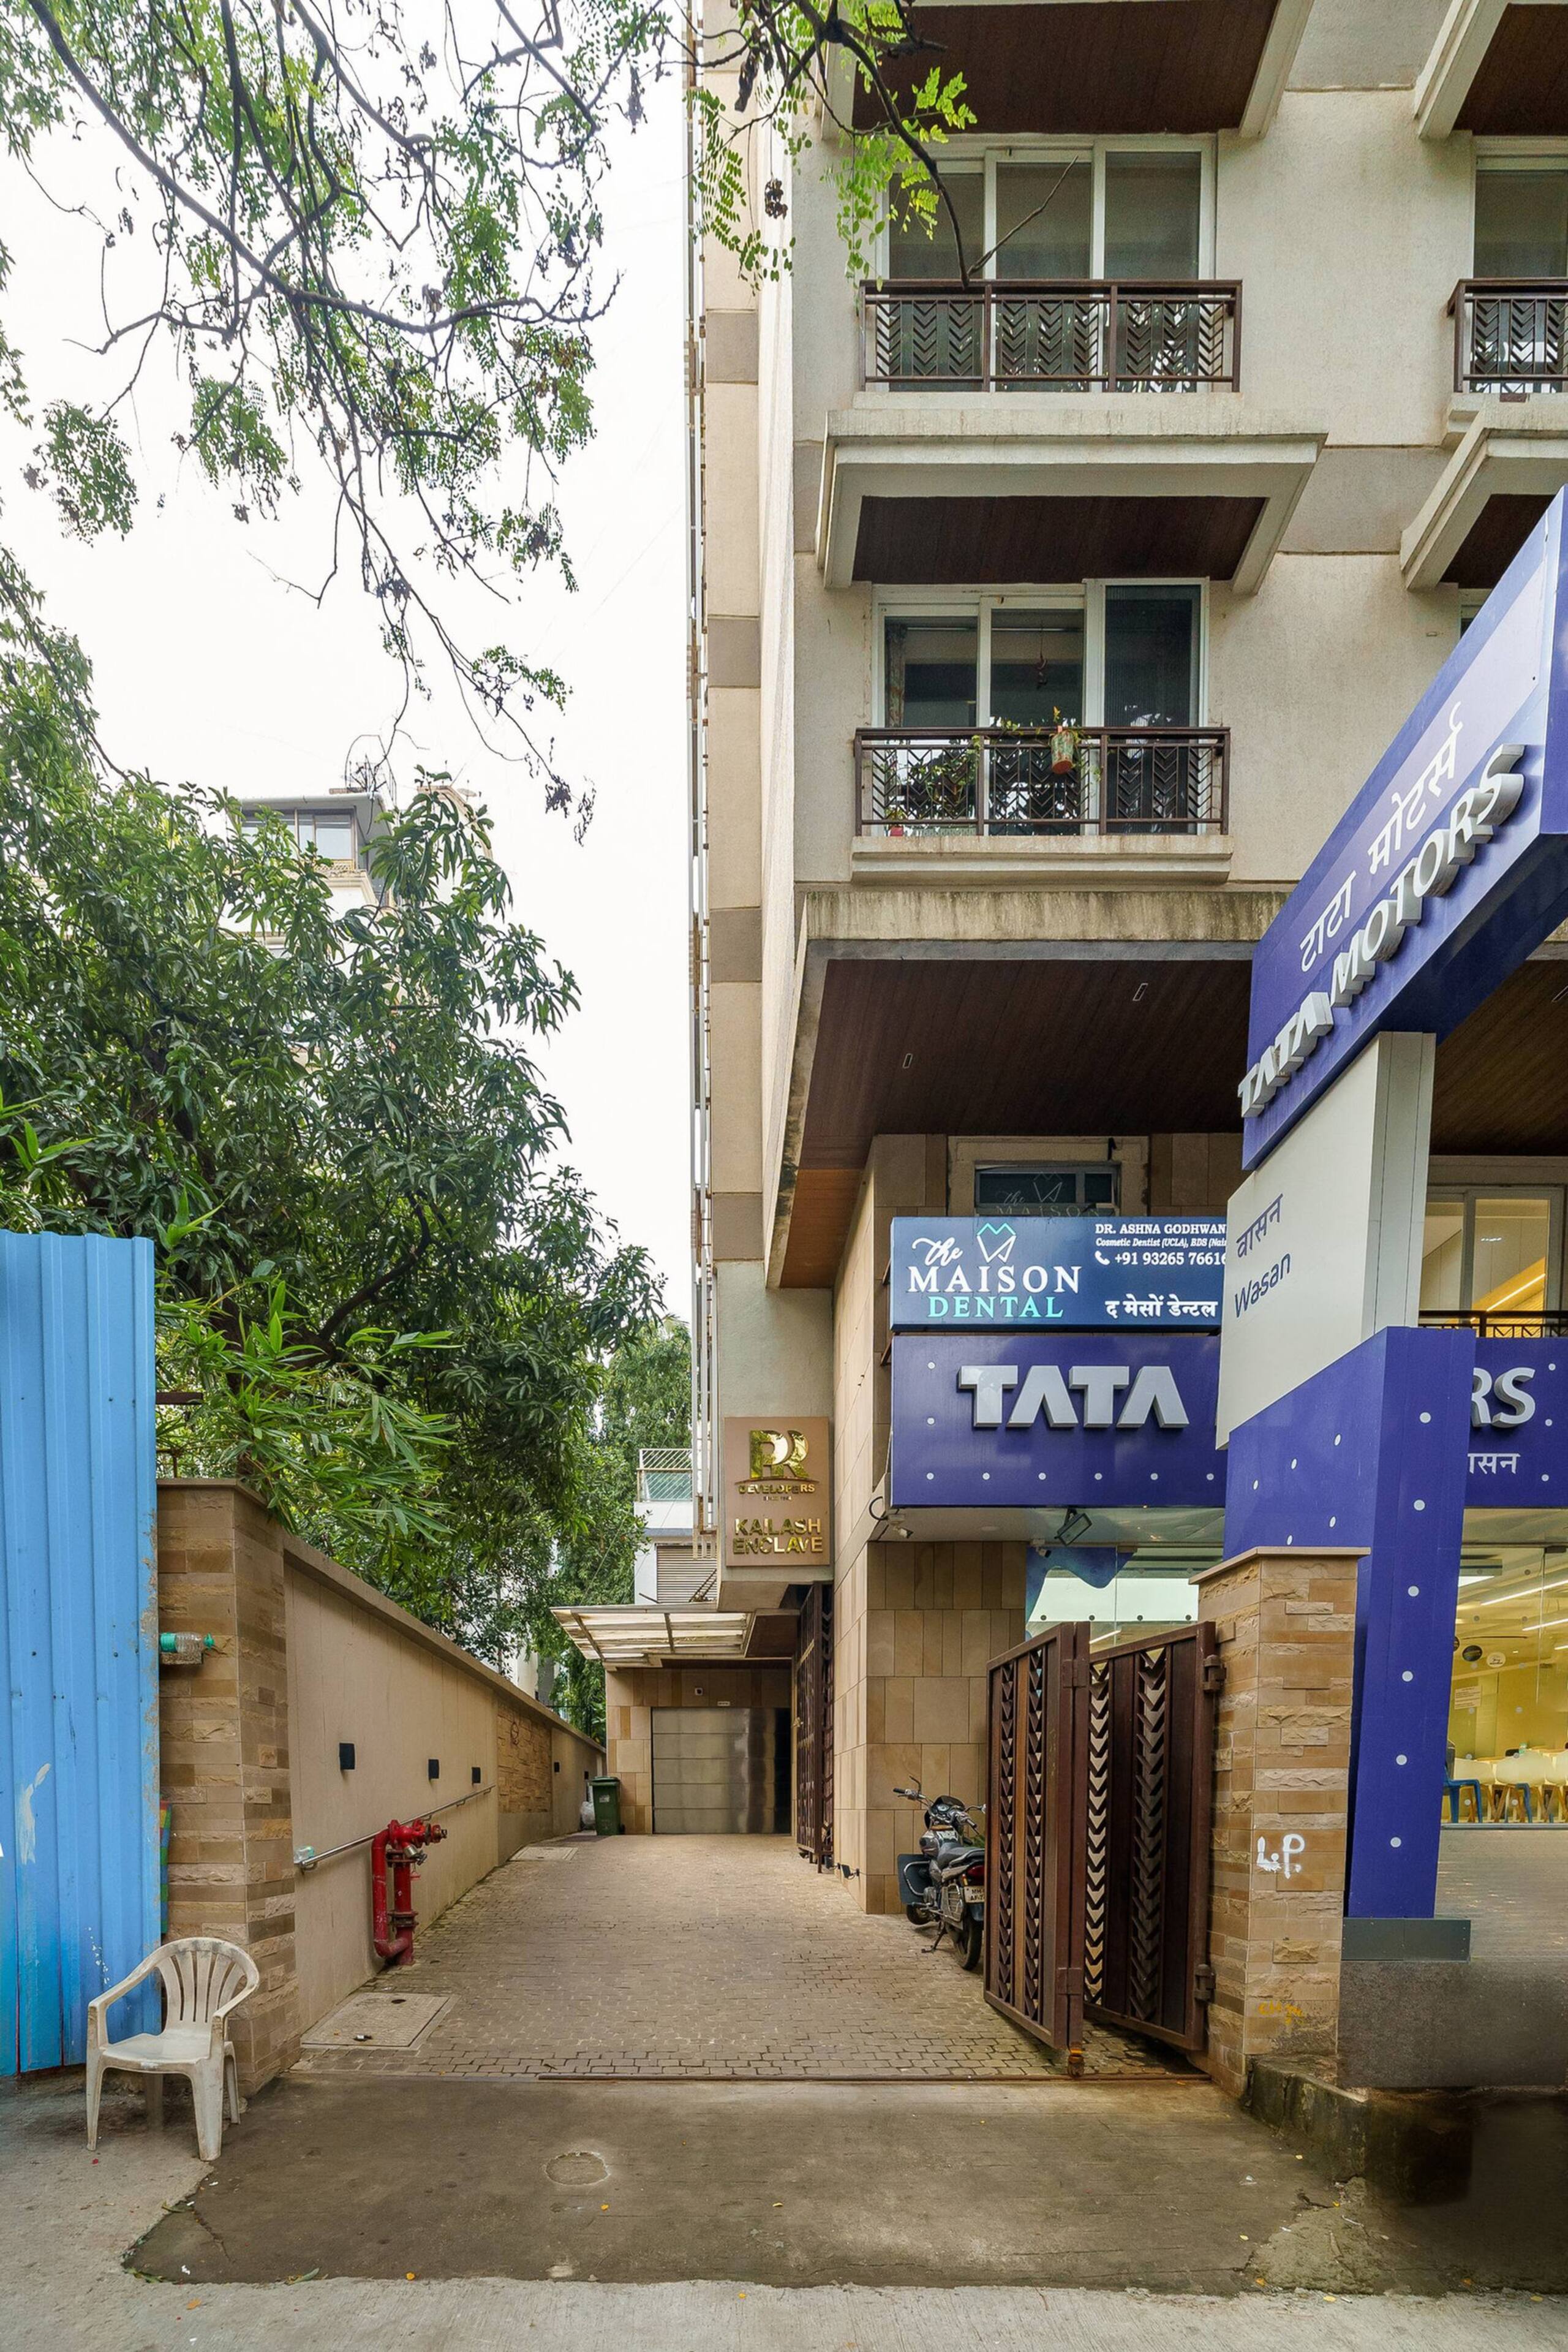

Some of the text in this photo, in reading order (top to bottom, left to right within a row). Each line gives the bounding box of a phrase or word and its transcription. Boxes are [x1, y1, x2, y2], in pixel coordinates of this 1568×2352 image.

[1299, 700, 1464, 972] टाटा मोटर्स
[1237, 744, 1526, 1117] TATA MOTORS
[1095, 1223, 1117, 1235] DR.
[1120, 1223, 1161, 1235] ASHNA
[1236, 1193, 1283, 1258] वासन
[1096, 1237, 1131, 1247] Cosmetic
[1132, 1237, 1161, 1247] Dentist
[1190, 1238, 1207, 1247] BDS
[1115, 1252, 1138, 1265] +91
[1142, 1252, 1185, 1265] 93265
[907, 1265, 1082, 1294] MAISON
[1234, 1253, 1291, 1318] Wasan
[927, 1295, 1064, 1318] DENTAL
[1104, 1300, 1120, 1318] द
[957, 1365, 1190, 1428] TATA
[738, 1483, 815, 1494] DEVELOPERS
[735, 1518, 821, 1535] KAILASH
[733, 1536, 824, 1554] ENCLAVE
